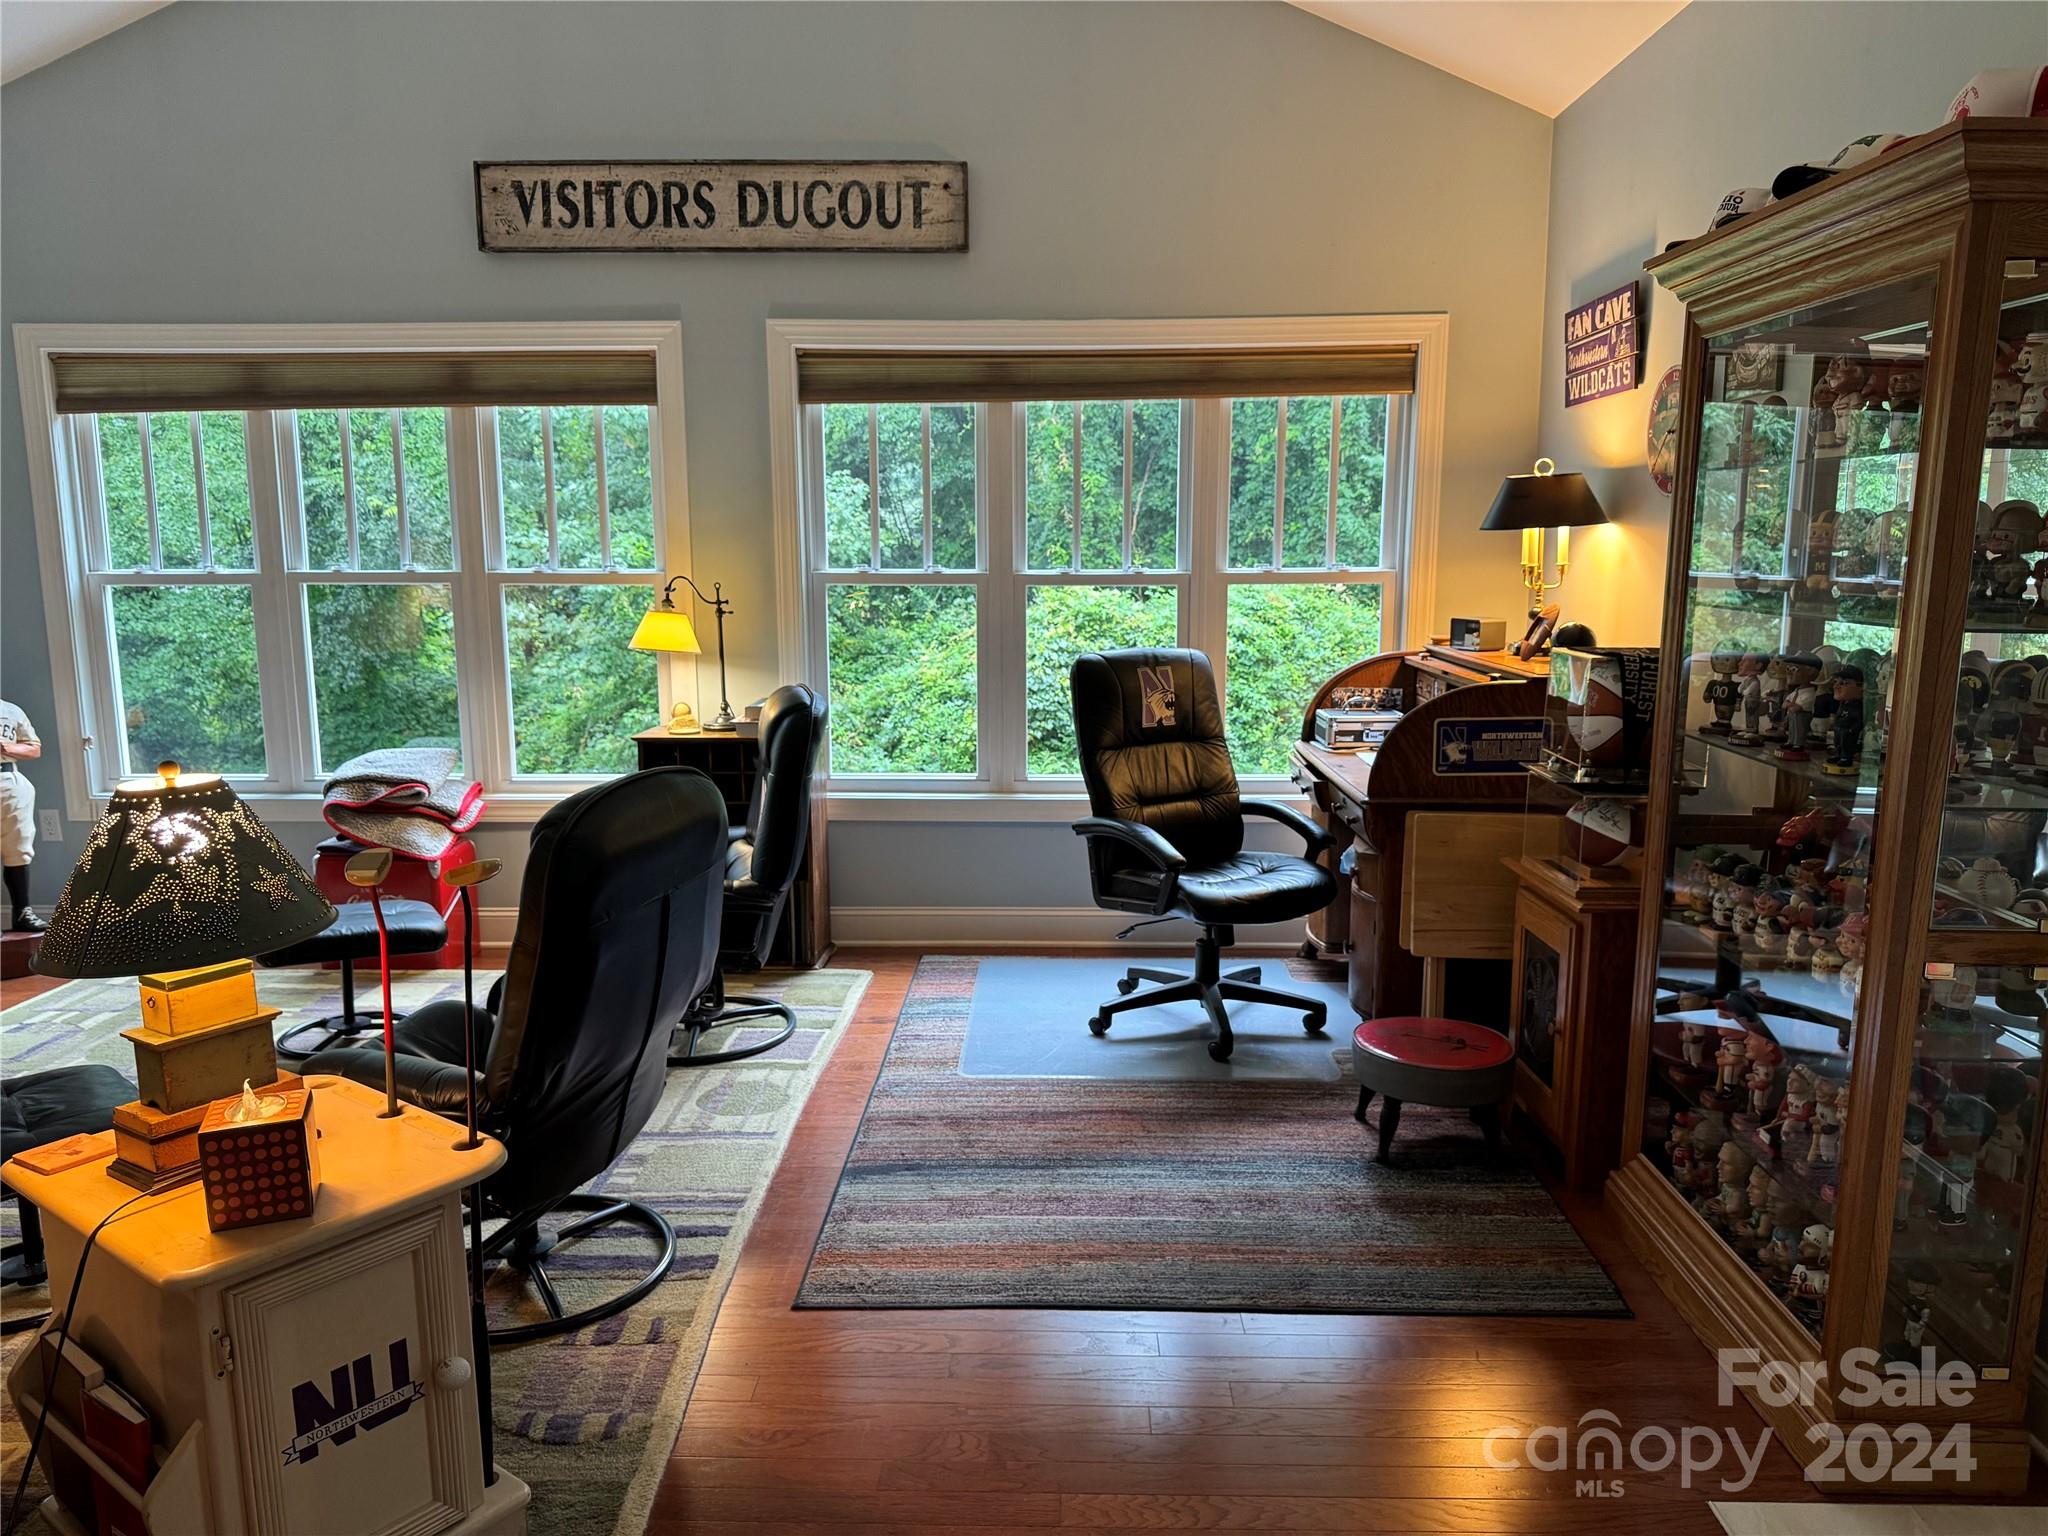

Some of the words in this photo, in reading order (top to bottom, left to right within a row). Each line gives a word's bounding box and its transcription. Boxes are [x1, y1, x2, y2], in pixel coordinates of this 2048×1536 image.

[510, 179, 716, 230] VISITORS
[737, 180, 931, 230] DUGOUT
[1567, 308, 1592, 342] FAN
[1595, 291, 1632, 329] CAVE
[1567, 361, 1632, 401] WILDCATS
[1624, 655, 1640, 704] ERSITY
[1712, 685, 1729, 698] 00
[0, 724, 16, 741] ES
[291, 1338, 412, 1464] NU
[306, 1389, 406, 1445] NORTHWESTERN
